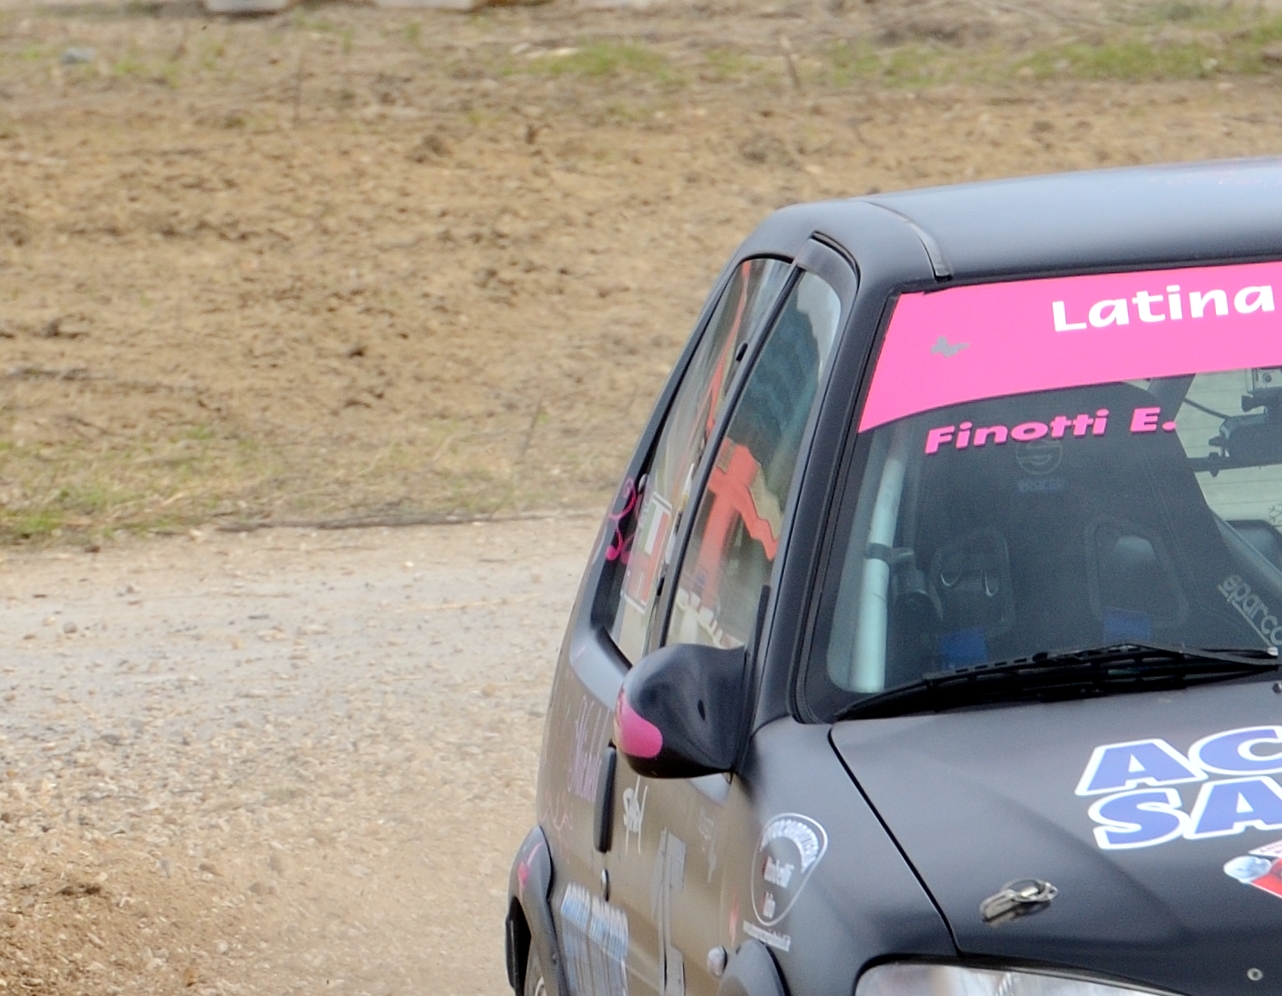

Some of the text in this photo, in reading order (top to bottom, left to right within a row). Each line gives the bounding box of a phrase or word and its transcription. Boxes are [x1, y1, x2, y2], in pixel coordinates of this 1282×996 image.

[1051, 284, 1276, 333] Latina
[924, 406, 1177, 455] Finotti E.
